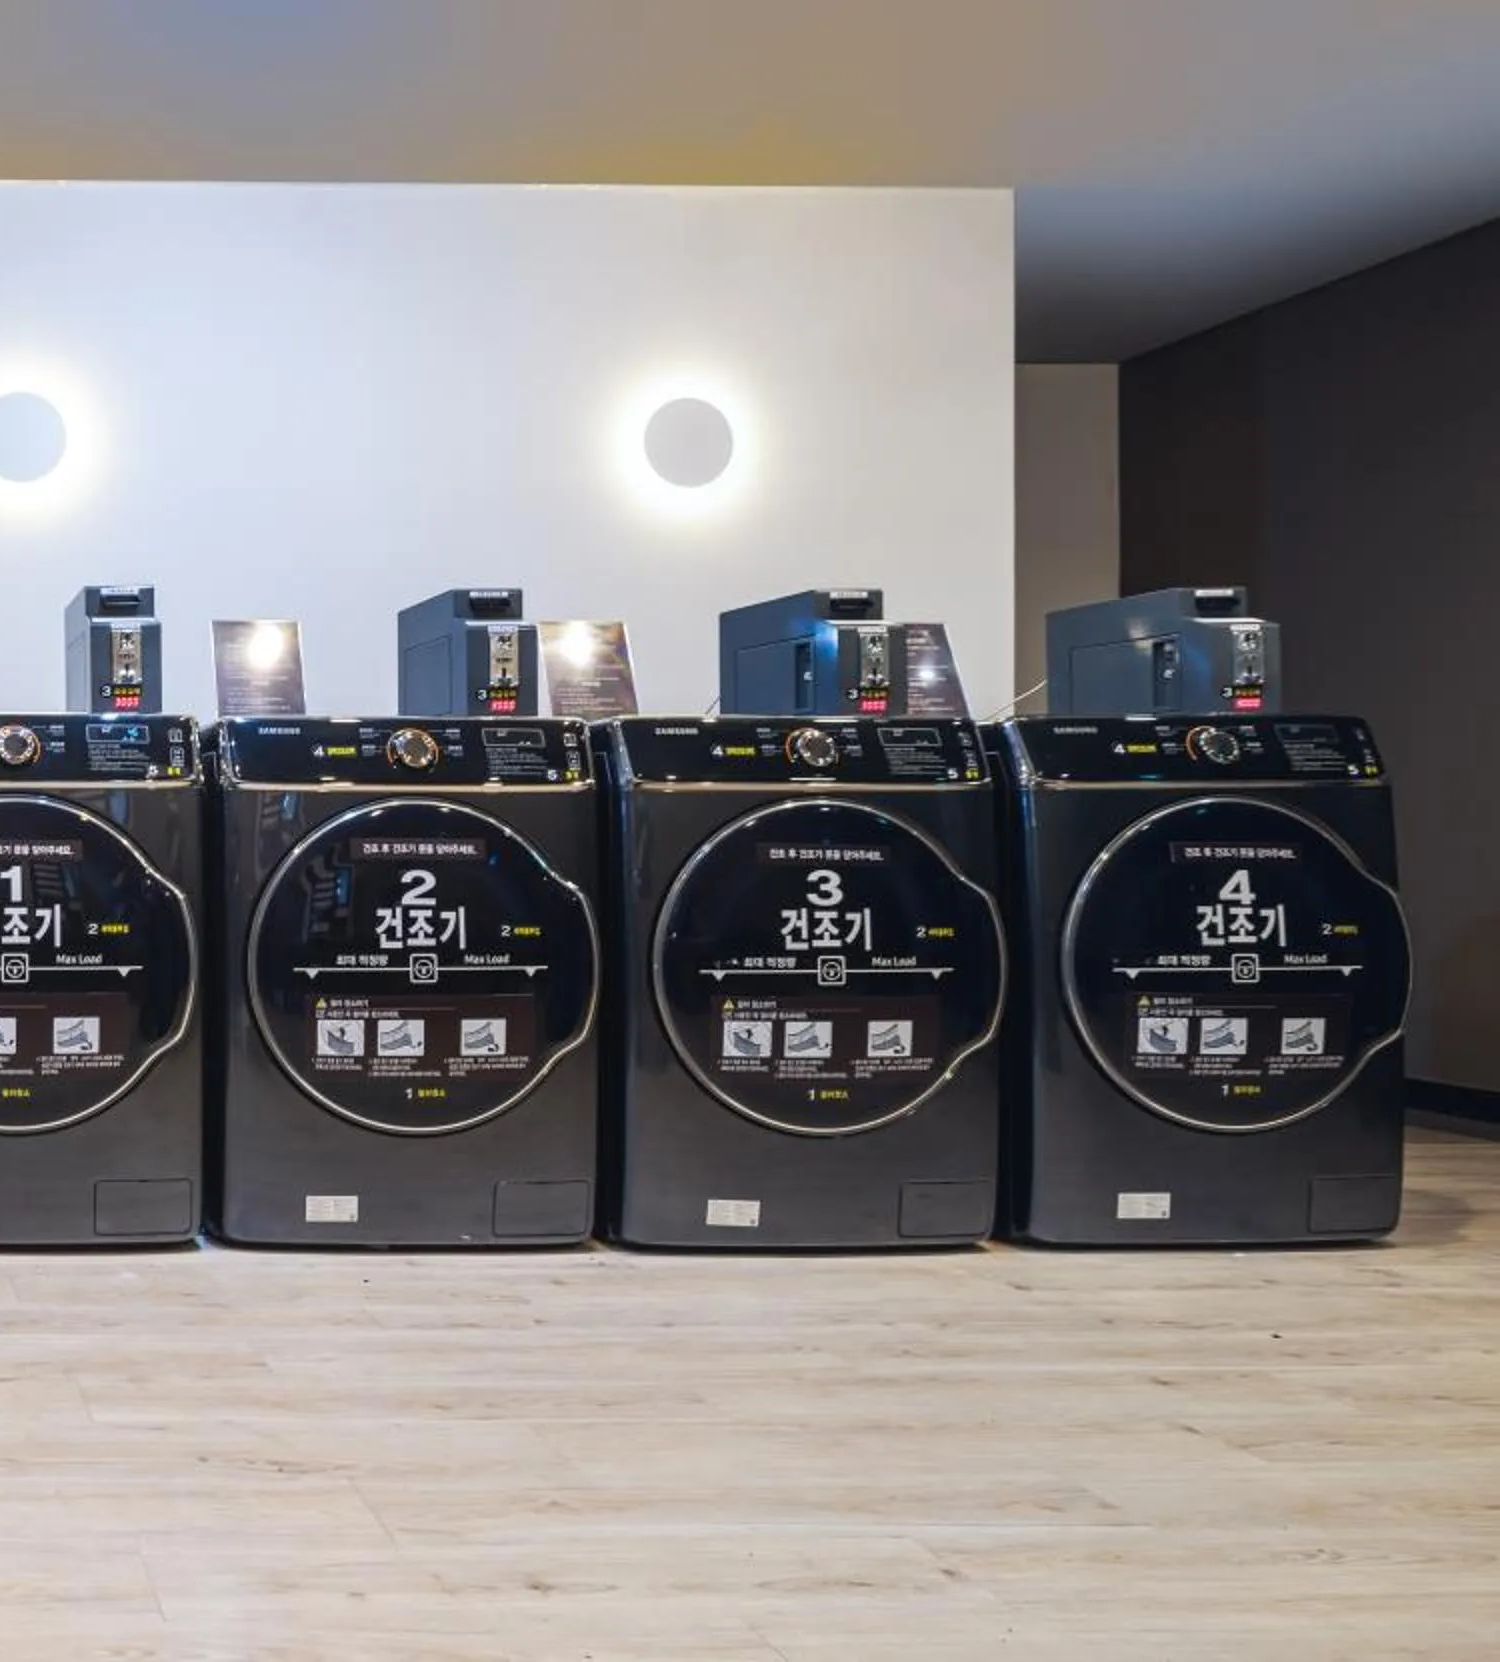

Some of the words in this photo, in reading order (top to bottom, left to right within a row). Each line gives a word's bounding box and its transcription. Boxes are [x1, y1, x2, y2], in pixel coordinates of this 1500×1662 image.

[258, 727, 301, 735] SAMSUNG
[0, 865, 23, 902] 1
[401, 869, 437, 905] 2
[806, 869, 844, 906] 3
[1218, 869, 1256, 905] 4
[87, 923, 98, 935] 2
[375, 906, 467, 950] 건조기
[501, 925, 511, 937] 2
[781, 907, 872, 951] 건조기
[1196, 903, 1286, 947] 건조기
[1322, 924, 1332, 934] 2
[916, 926, 926, 938] 2
[56, 954, 78, 965] Max
[79, 954, 103, 965] Load
[464, 954, 485, 964] Max
[486, 953, 510, 964] Load
[872, 956, 893, 966] Max
[894, 955, 916, 966] Load
[1284, 954, 1304, 964] Max
[1305, 953, 1328, 964] Load
